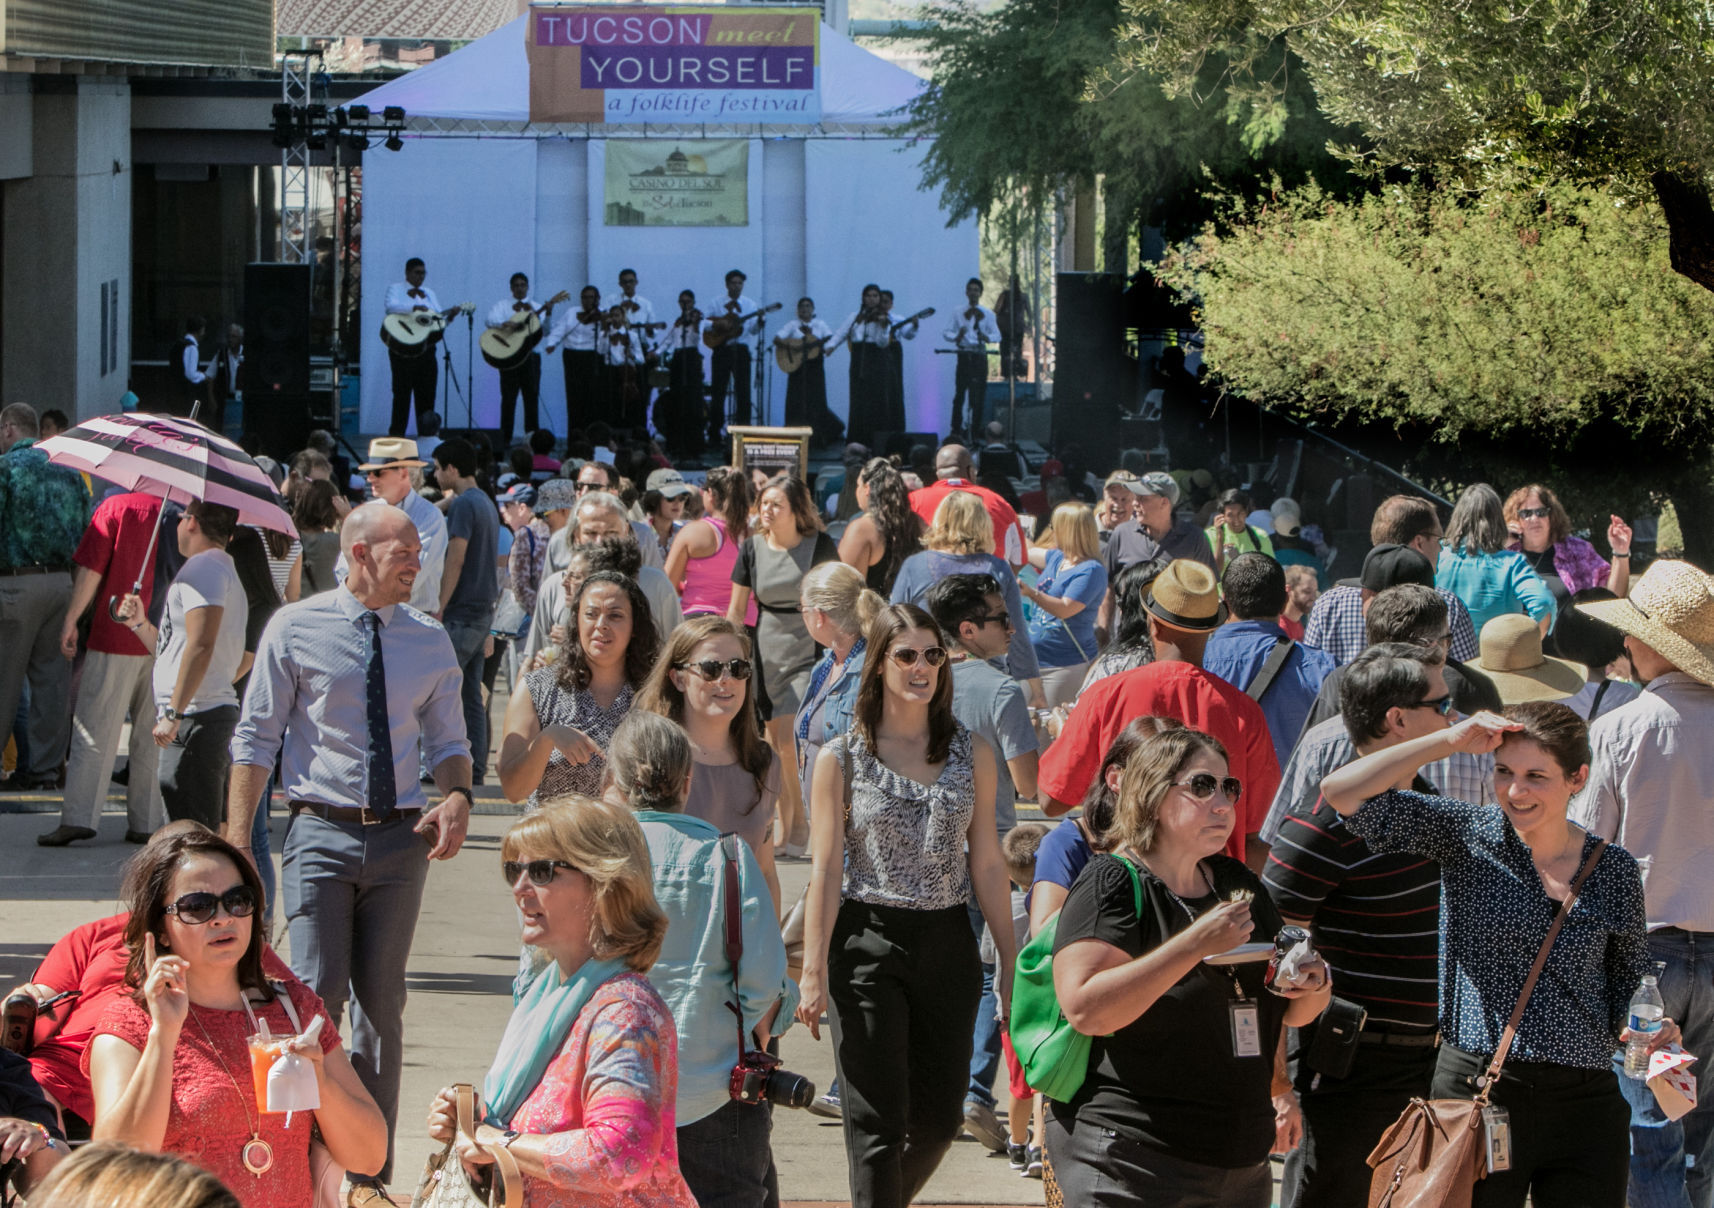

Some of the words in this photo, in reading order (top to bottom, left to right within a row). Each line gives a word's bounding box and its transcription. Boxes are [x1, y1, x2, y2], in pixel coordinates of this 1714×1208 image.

[542, 17, 701, 44] TUCSON
[716, 21, 797, 43] meet
[588, 57, 805, 83] YOURSELF
[608, 98, 622, 112] a
[624, 92, 712, 117] folklife
[718, 92, 809, 117] festival
[629, 178, 675, 189] CASINO
[678, 178, 700, 189] DEL
